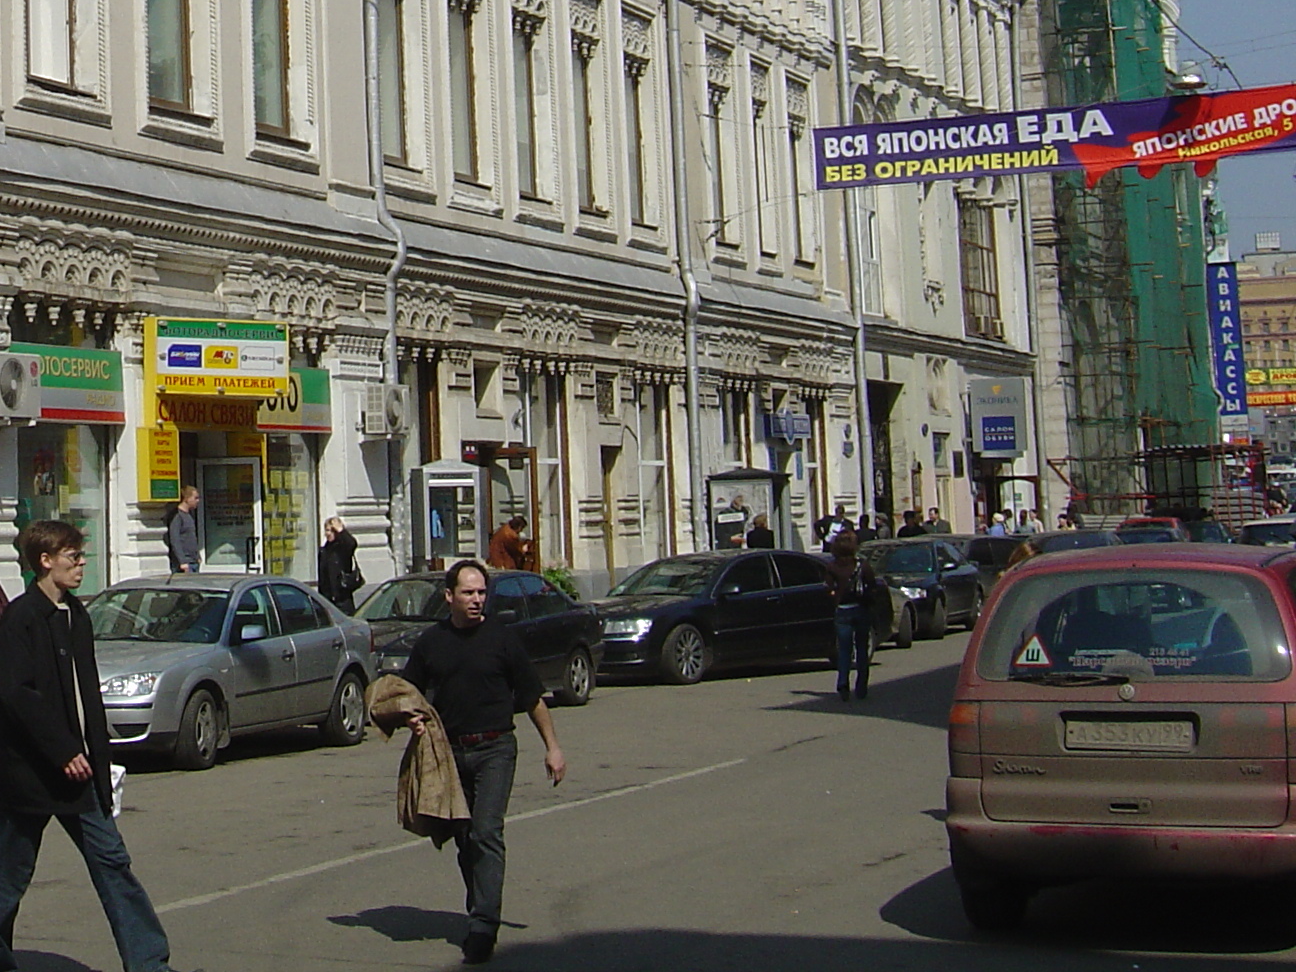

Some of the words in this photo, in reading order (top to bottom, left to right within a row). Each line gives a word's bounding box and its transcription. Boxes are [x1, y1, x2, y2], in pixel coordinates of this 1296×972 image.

[824, 135, 868, 159] ВСЯ
[877, 122, 1009, 155] ЯПОНСКАЯ
[1016, 109, 1114, 144] ЕДА
[1132, 112, 1248, 158] ЯПОНСКИЕ
[825, 163, 867, 182] БЕЗ
[874, 145, 1060, 179] ОГРАНИЧЕНИЙ
[1217, 266, 1240, 411] АВИАКАССЫ
[165, 376, 206, 386] ПРИЕМ
[214, 377, 275, 388] ПЛАТЕЖЕЙ
[159, 399, 207, 422] САЛОН
[1026, 648, 1040, 662] Ш
